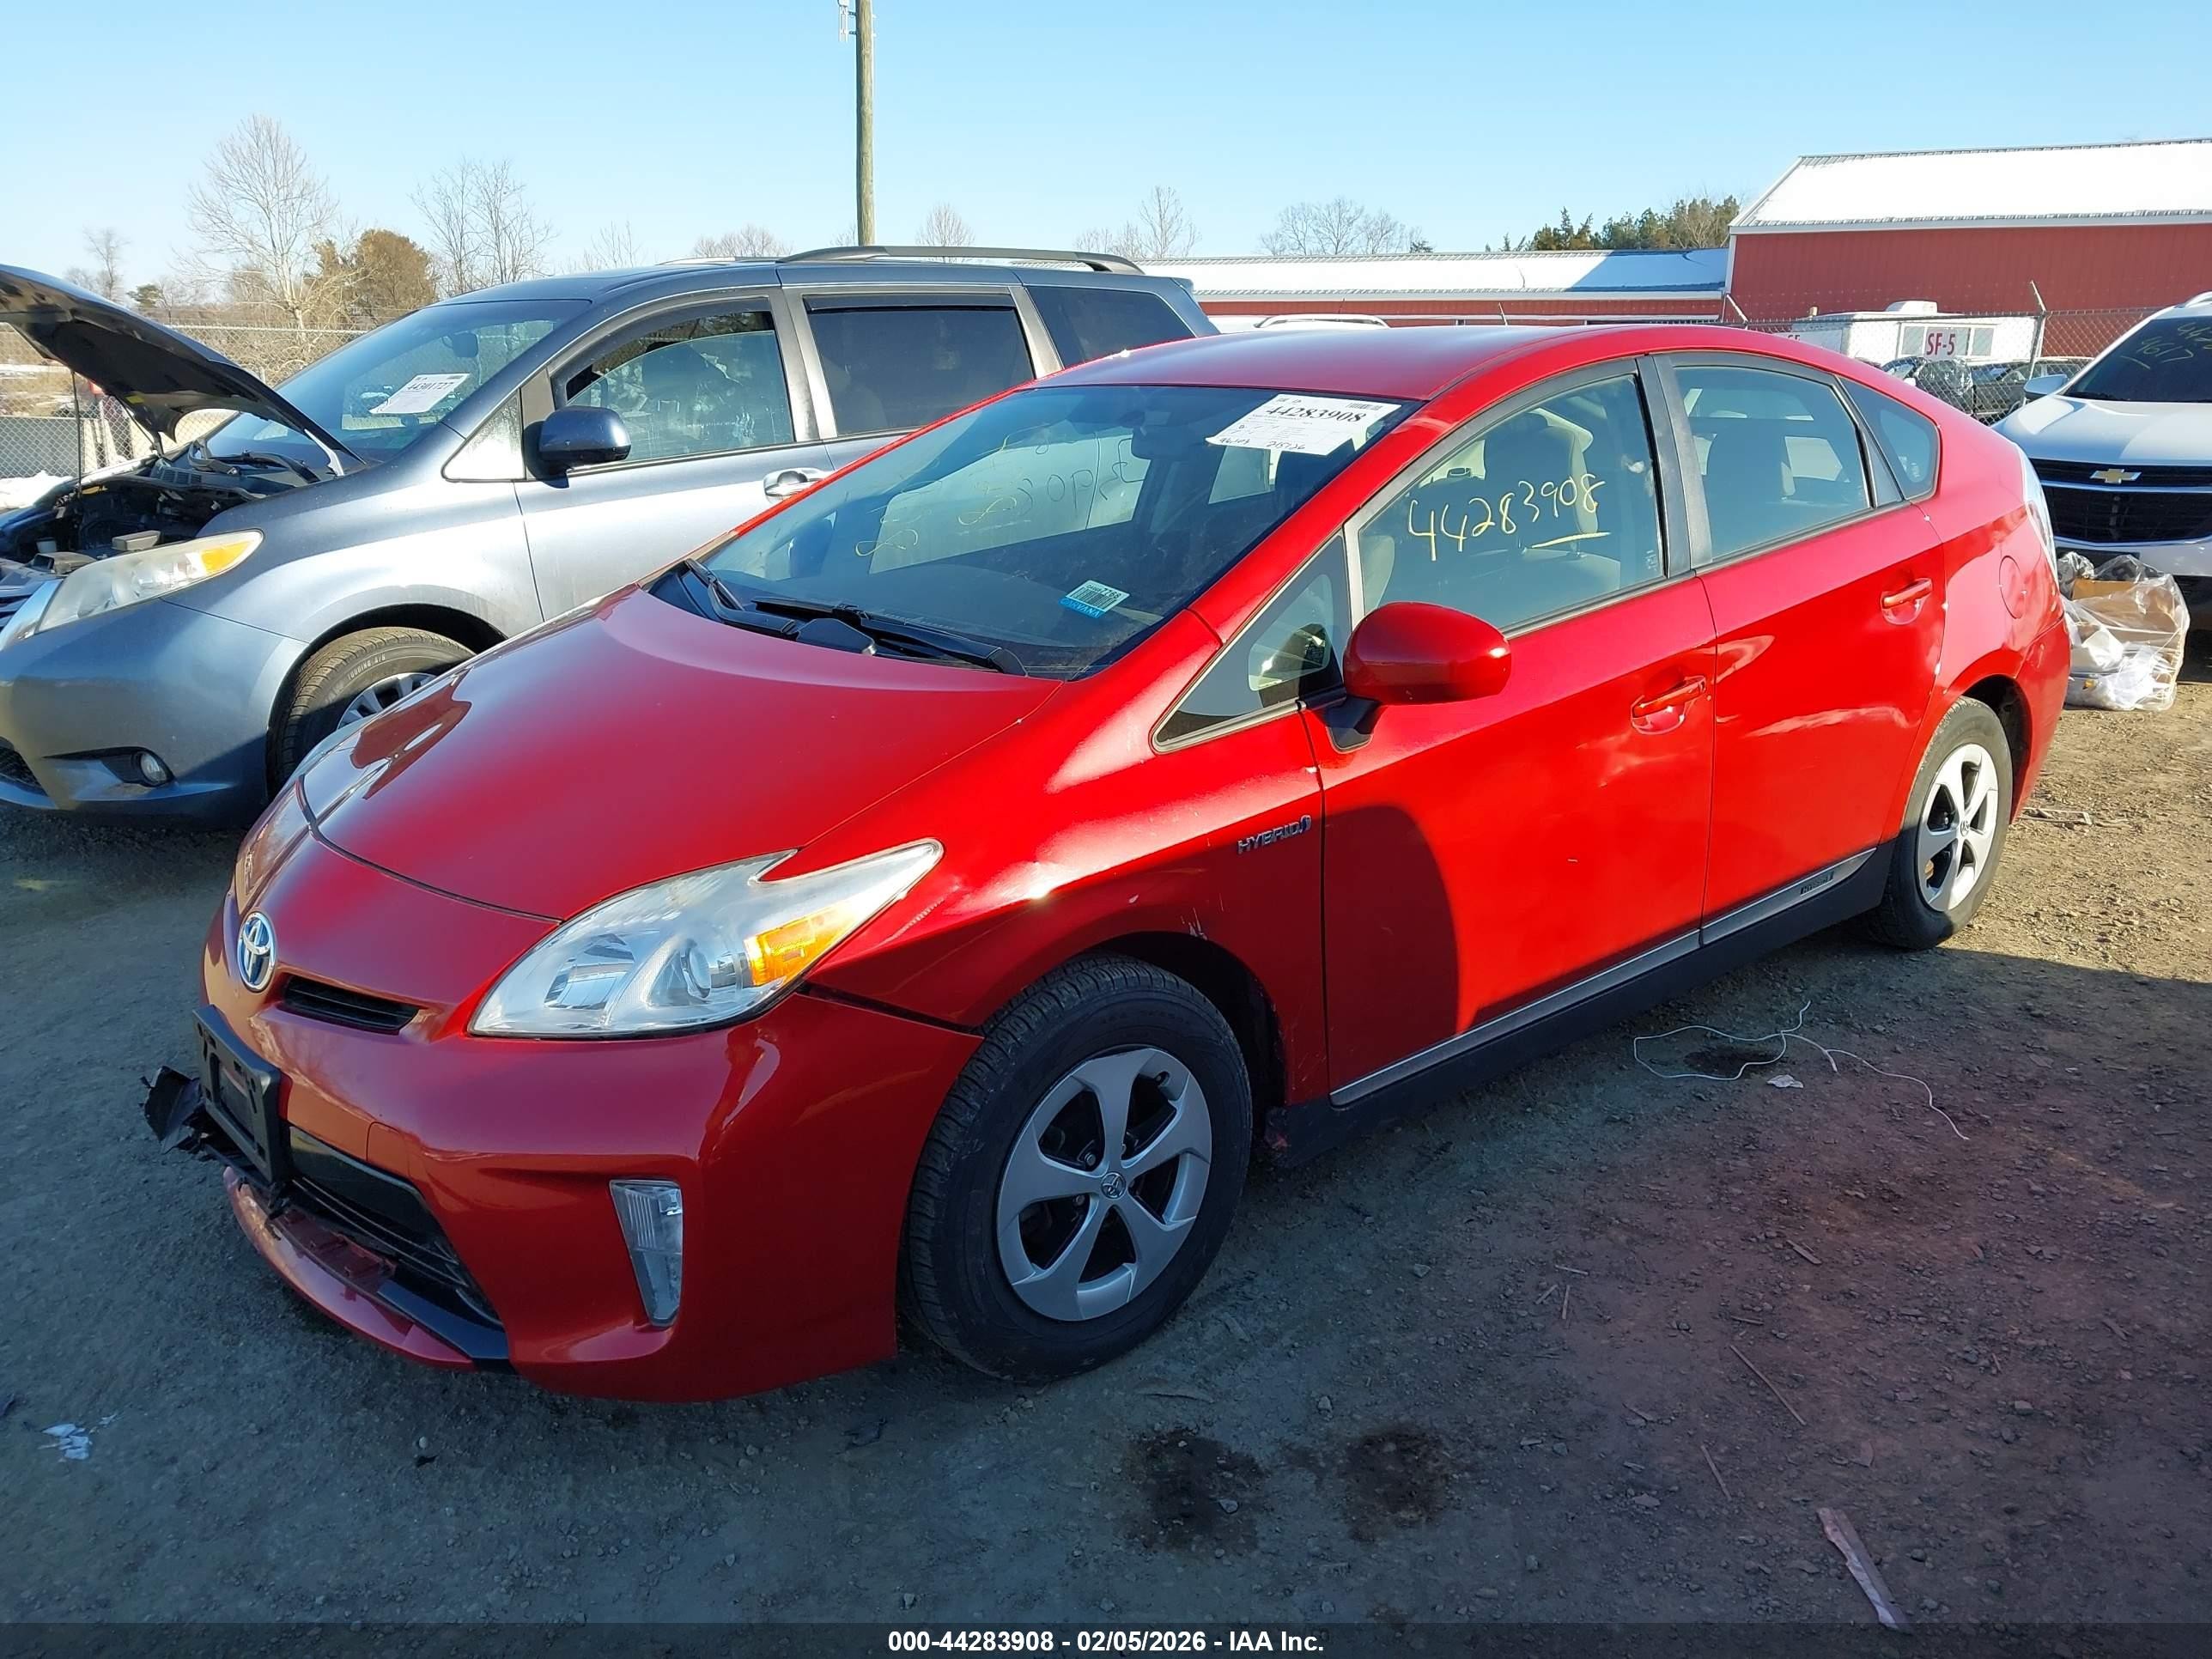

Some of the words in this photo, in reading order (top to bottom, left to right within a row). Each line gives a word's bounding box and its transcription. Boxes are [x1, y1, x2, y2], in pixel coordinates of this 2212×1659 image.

[1926, 332, 1956, 356] SF-5
[1266, 406, 1367, 423] 44283908
[1408, 474, 1605, 561] 44283908
[1237, 821, 1302, 854] HYBRID
